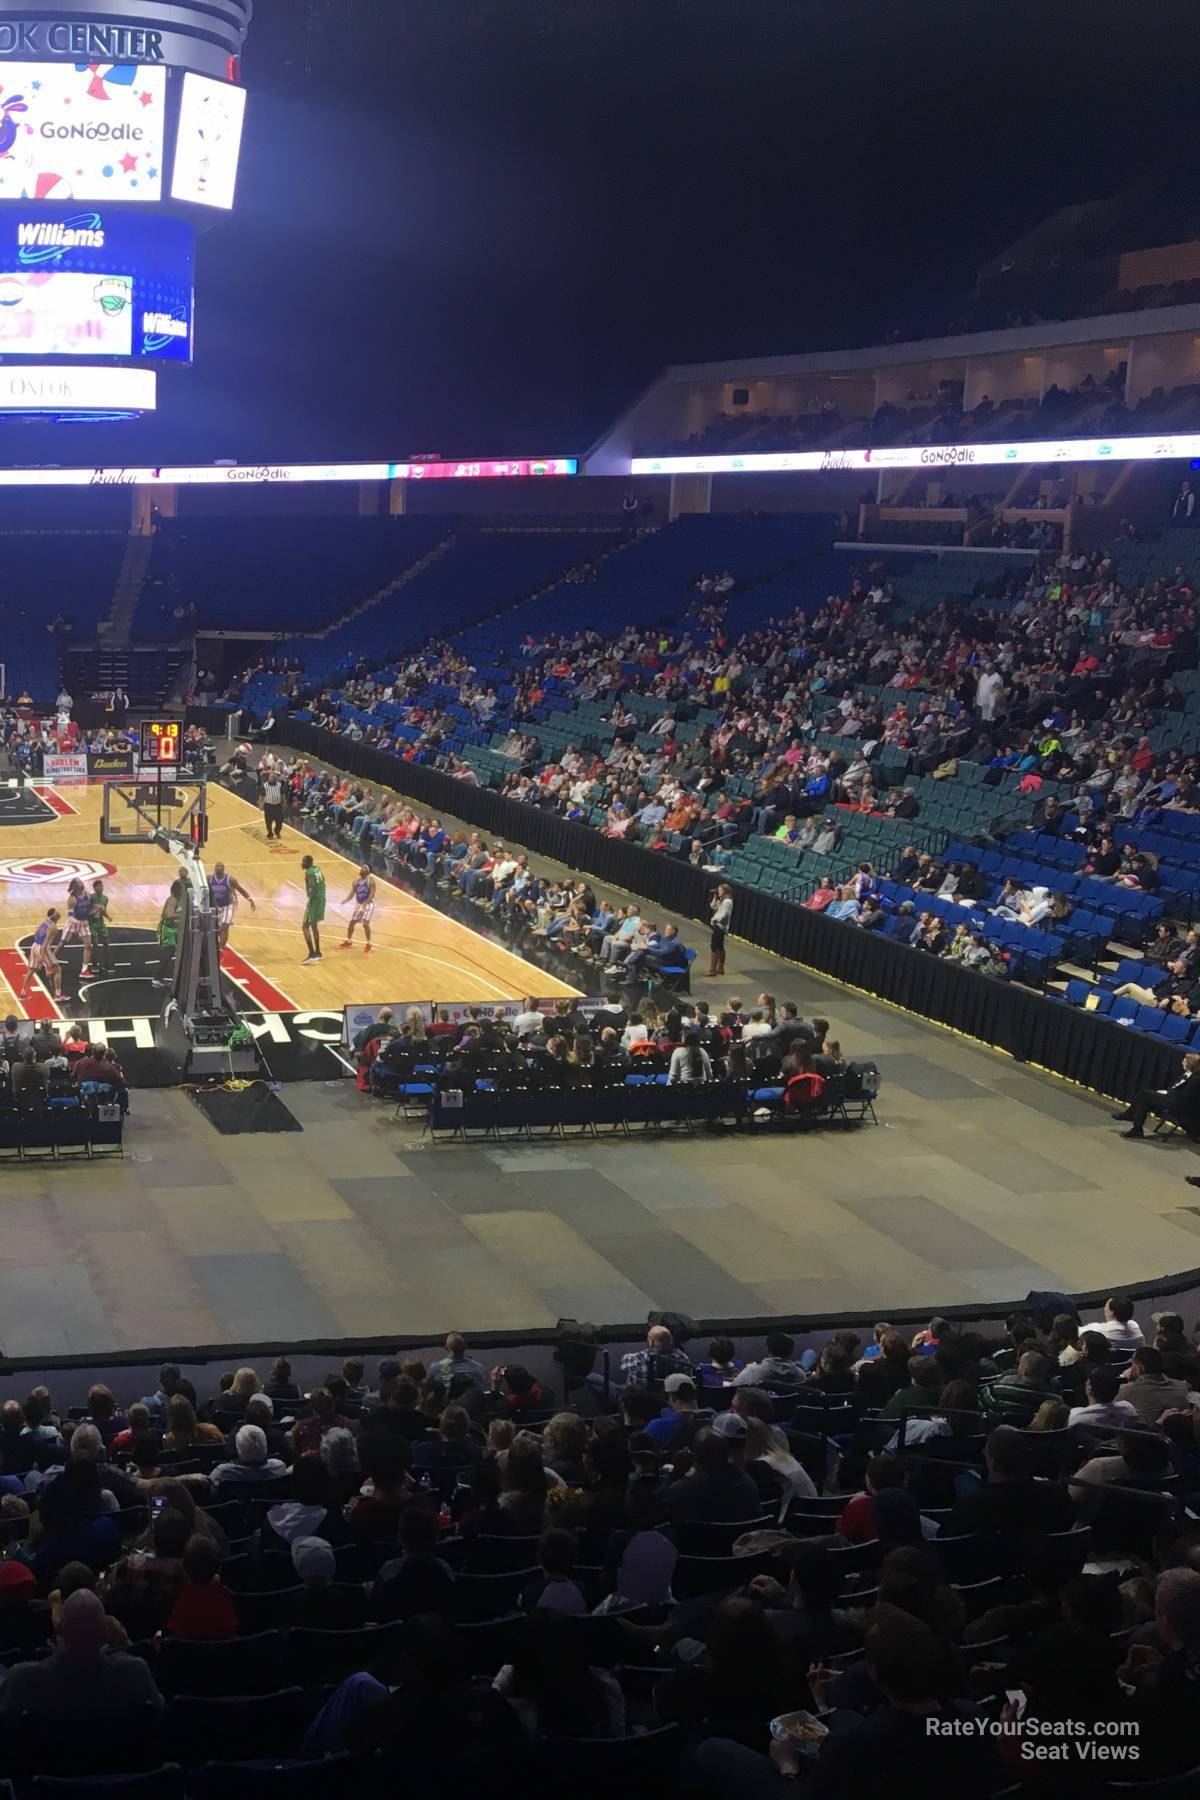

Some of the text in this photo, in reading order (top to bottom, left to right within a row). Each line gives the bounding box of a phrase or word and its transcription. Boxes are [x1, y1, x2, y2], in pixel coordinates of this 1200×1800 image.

[48, 24, 164, 60] CENTER
[40, 119, 144, 142] GoNoodle
[18, 223, 105, 247] Williams
[920, 446, 976, 465] GoNoodle
[227, 465, 291, 482] GoNoodle
[151, 724, 179, 737] 9:13
[161, 737, 174, 760] 0
